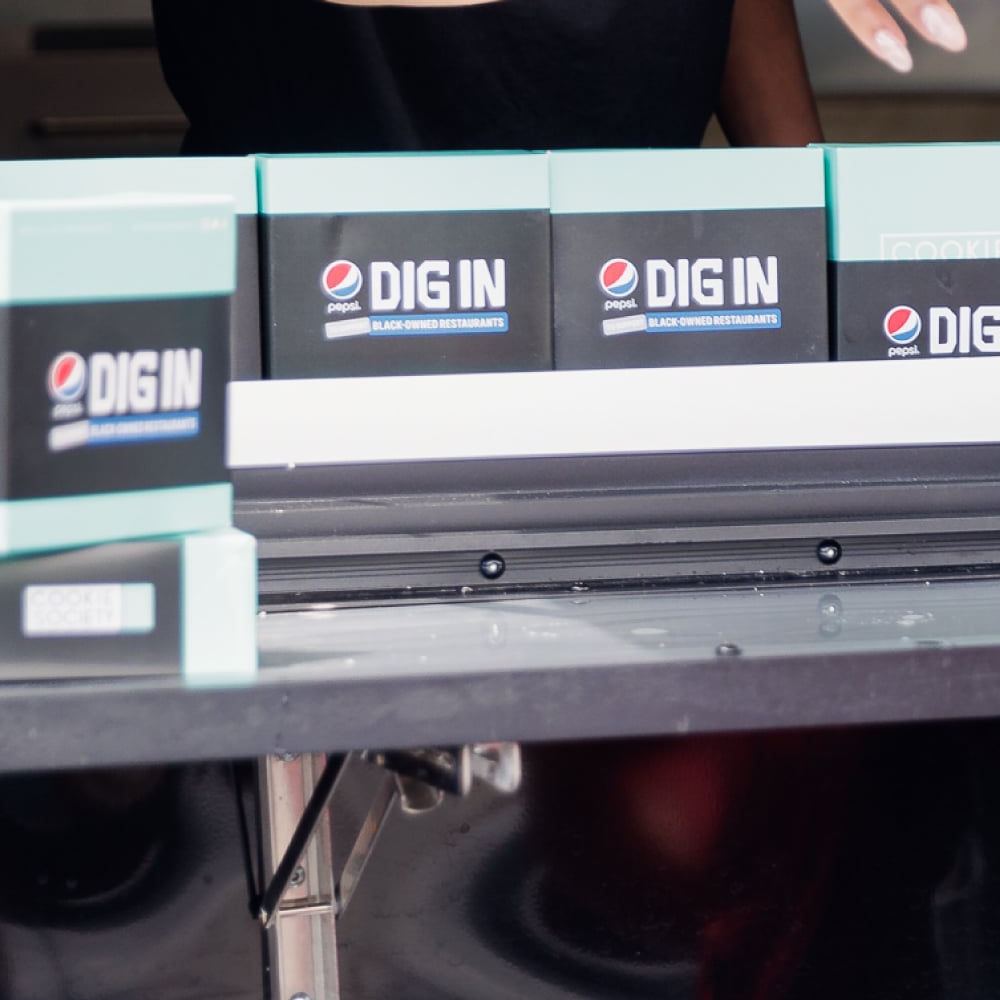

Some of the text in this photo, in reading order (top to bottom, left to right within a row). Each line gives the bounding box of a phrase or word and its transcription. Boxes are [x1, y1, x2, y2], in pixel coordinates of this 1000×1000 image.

[370, 259, 506, 310] DIG IN
[646, 256, 779, 308] DIG IN
[371, 319, 438, 331] BLACK-OWNED
[439, 316, 504, 330] RESTAURANTS
[648, 316, 712, 328] BLACK-OWNED
[713, 313, 778, 326] RESTAURANTS
[88, 347, 203, 417] DIG IN
